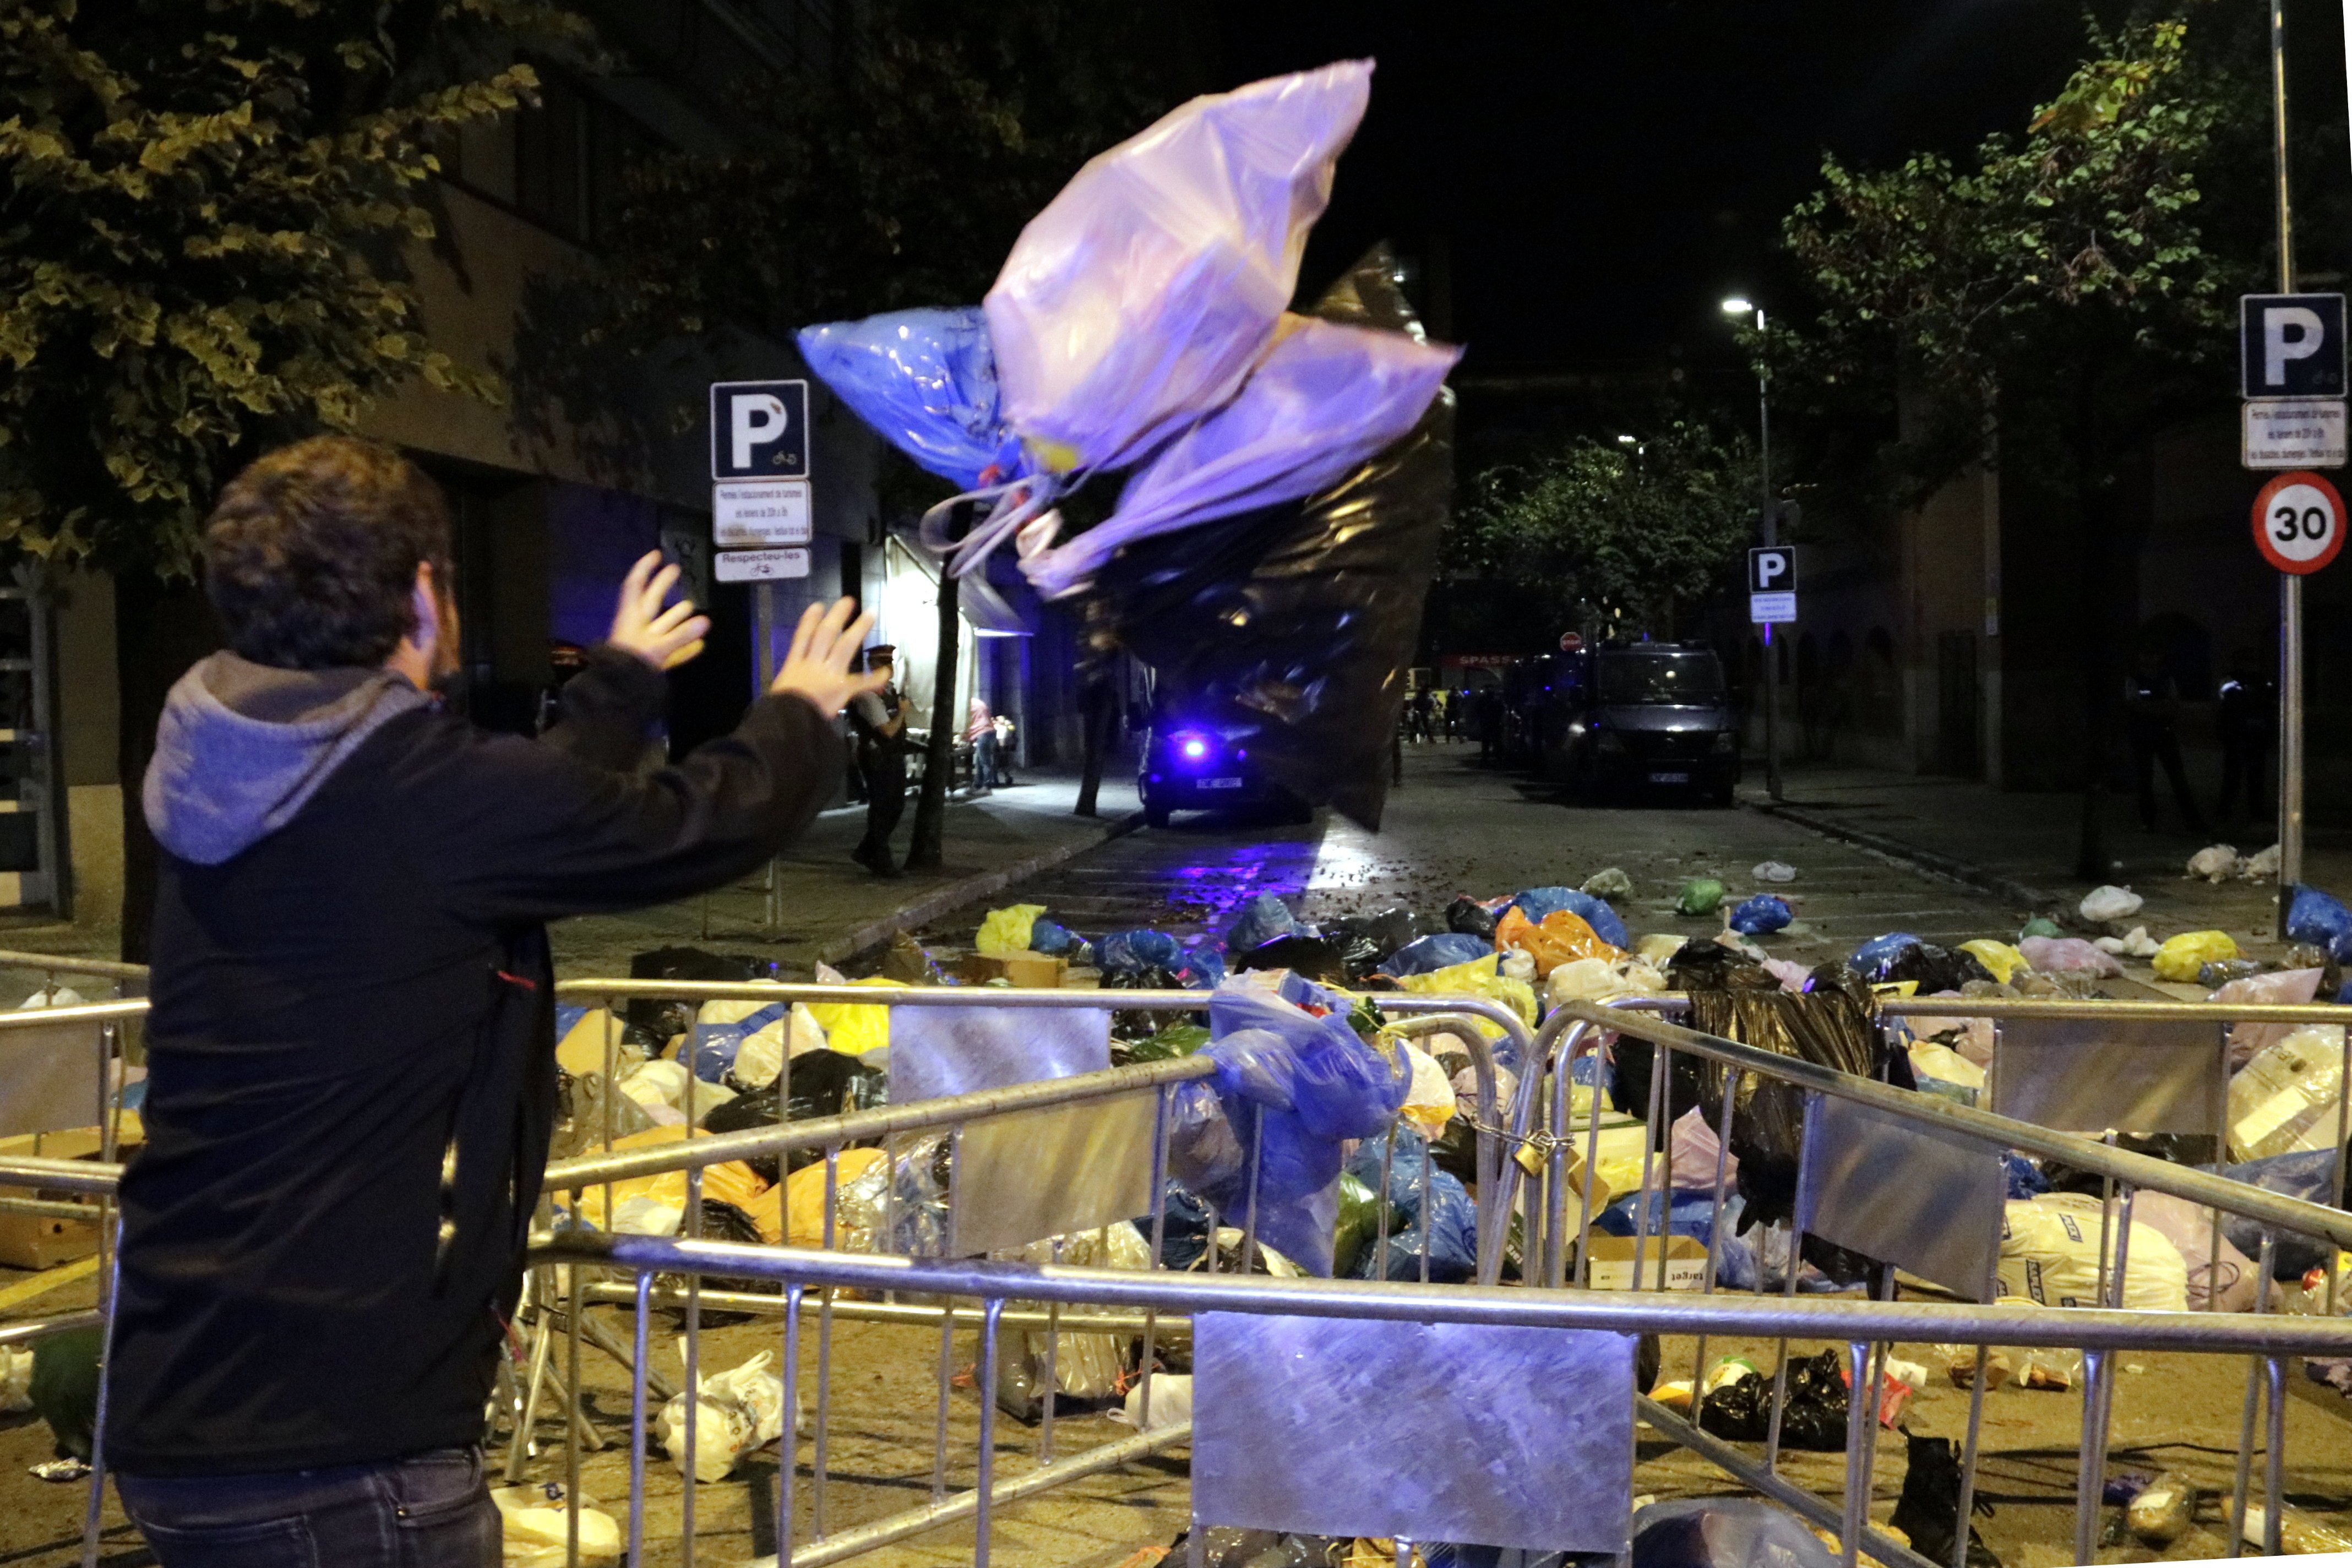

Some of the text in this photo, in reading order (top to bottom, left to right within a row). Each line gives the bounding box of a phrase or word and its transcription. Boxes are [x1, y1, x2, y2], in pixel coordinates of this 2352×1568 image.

[2264, 307, 2324, 385] P
[731, 393, 788, 469] P
[2274, 507, 2327, 542] 30
[722, 552, 800, 564] Respecteu-les
[1758, 553, 1786, 588] P
[1672, 1272, 1703, 1281] target
